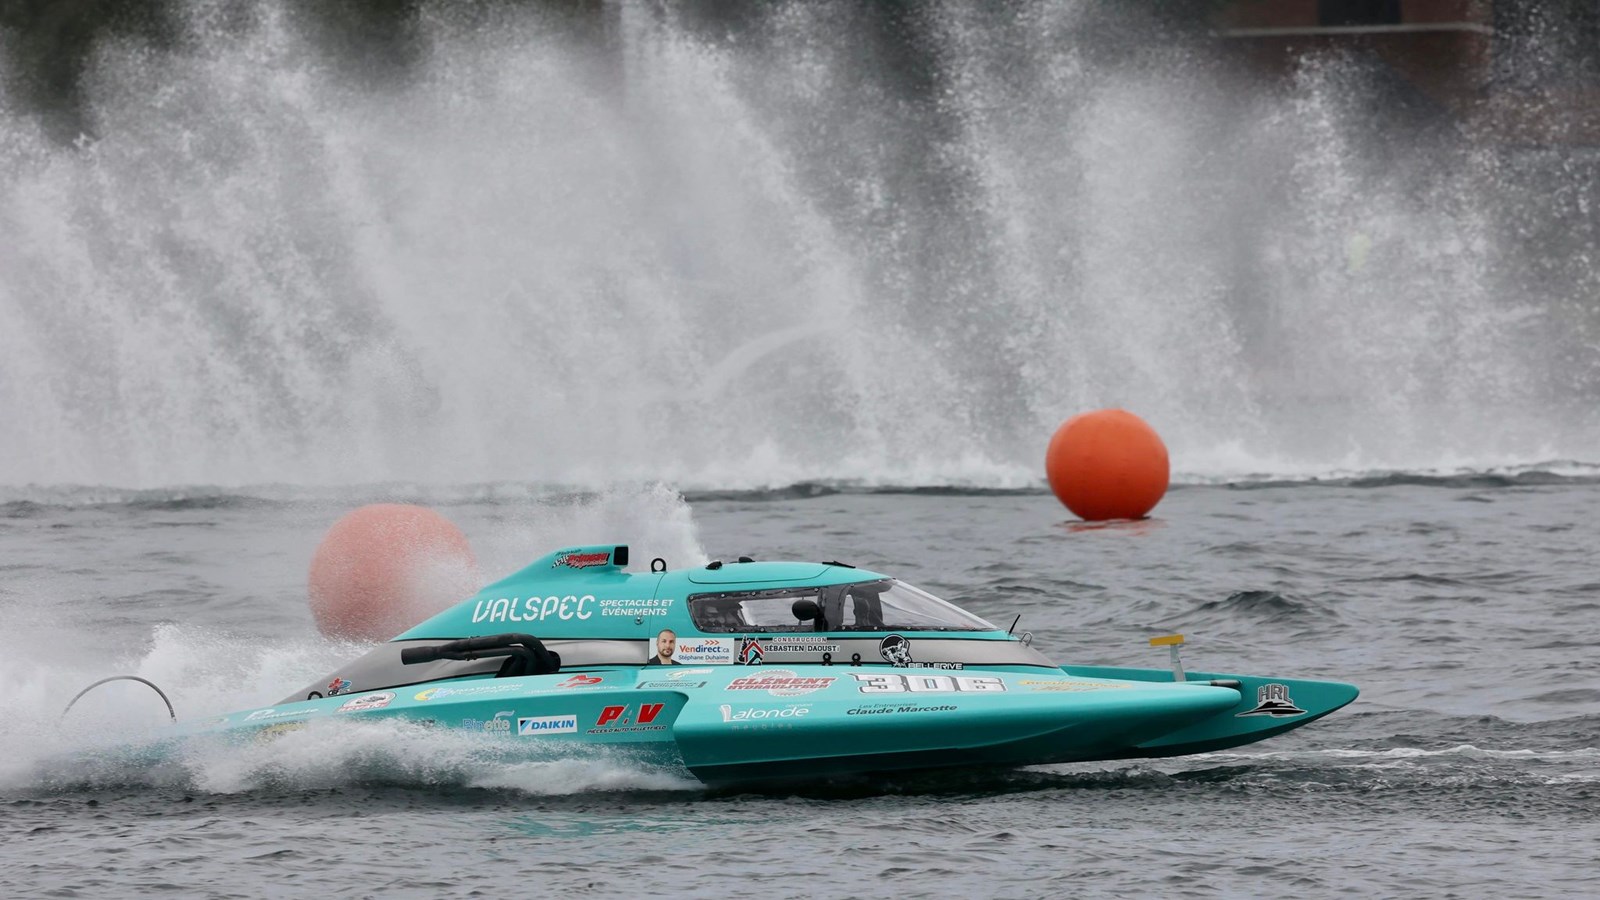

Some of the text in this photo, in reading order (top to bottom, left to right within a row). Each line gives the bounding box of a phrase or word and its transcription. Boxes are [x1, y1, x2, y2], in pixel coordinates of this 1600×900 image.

[599, 599, 674, 607] SPECTACLES ET
[472, 595, 595, 623] VALSPEC
[602, 607, 668, 616] ÉVÉNEMENTS
[764, 643, 805, 652] SÉBASTIEN
[908, 662, 963, 670] BELLERIVE
[731, 677, 837, 685] CLÉMENT
[848, 673, 1008, 694] 306
[1258, 683, 1293, 705] HRL
[846, 704, 958, 715] Claude Marcotte
[531, 720, 575, 730] DAIKIN
